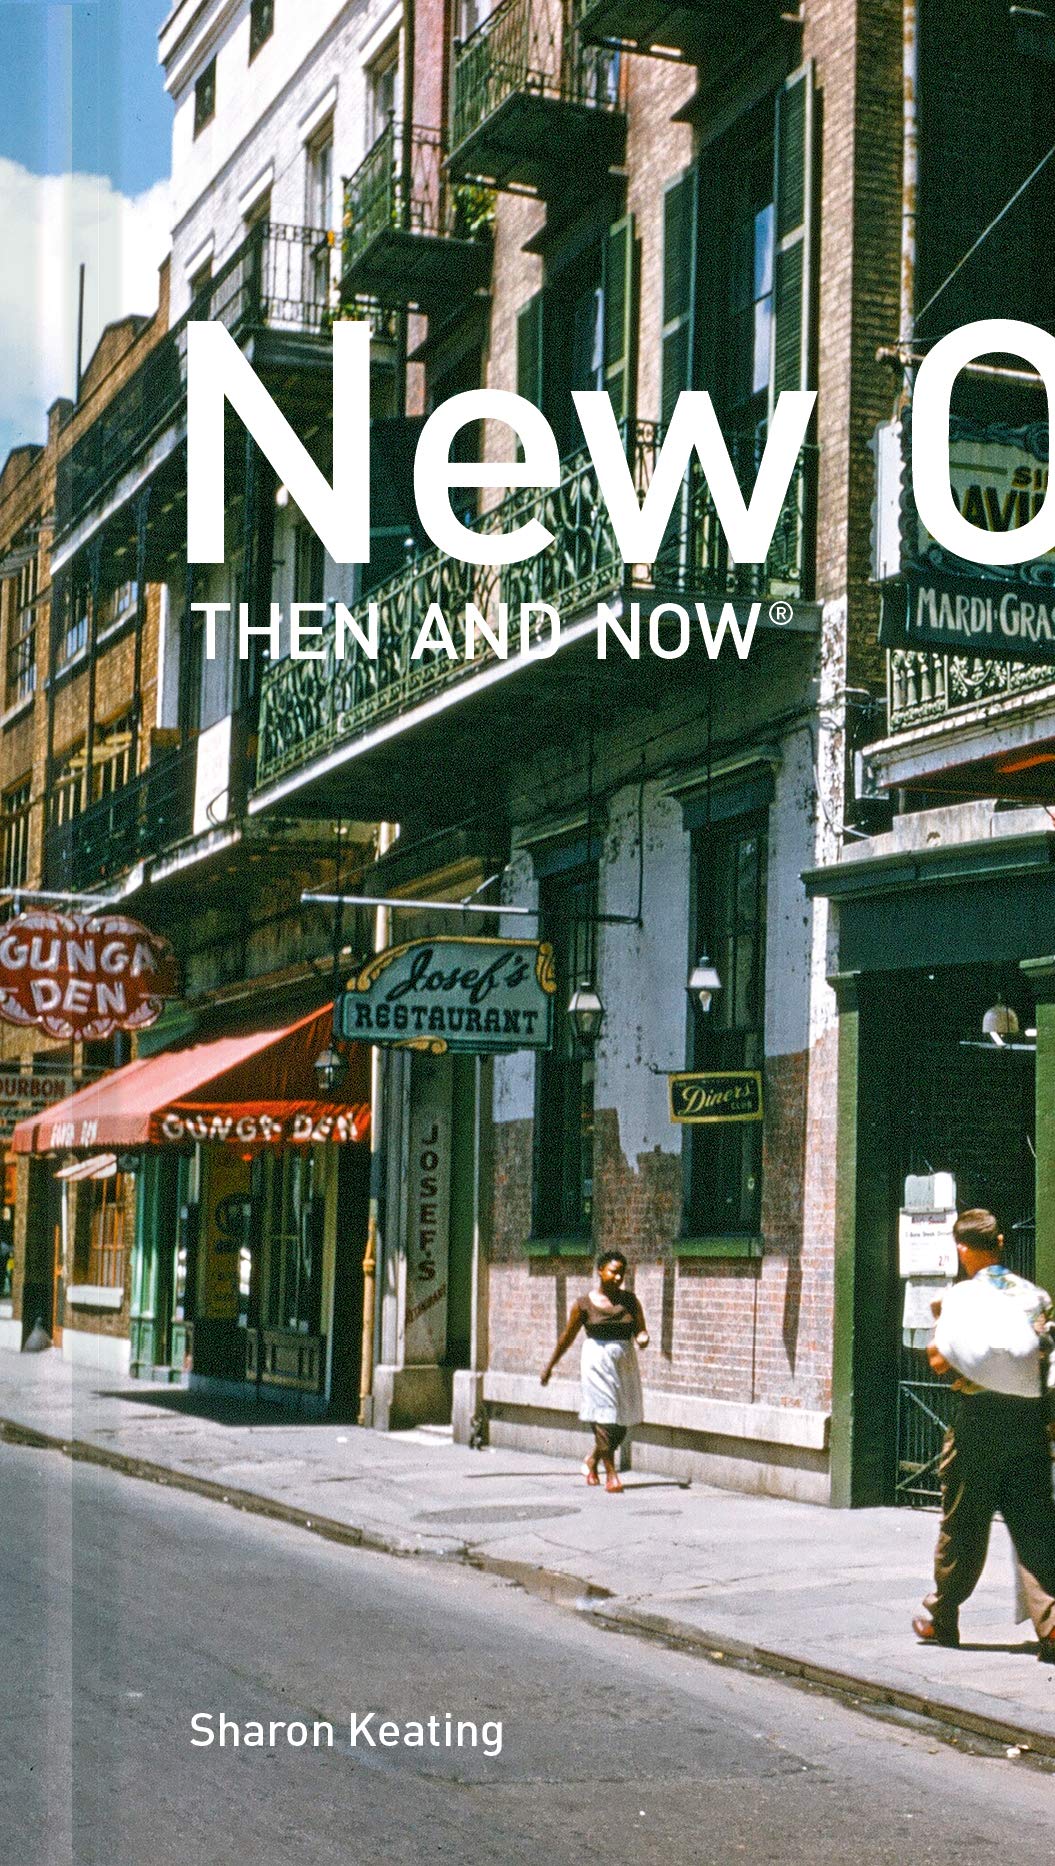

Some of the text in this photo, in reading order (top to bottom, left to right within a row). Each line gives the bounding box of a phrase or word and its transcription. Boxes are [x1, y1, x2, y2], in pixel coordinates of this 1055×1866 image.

[0, 934, 158, 977] GUNGA
[384, 949, 531, 1004] Josef's
[30, 977, 128, 1015] DEN
[355, 1002, 538, 1034] RESTAURANT
[678, 1083, 751, 1114] Diners
